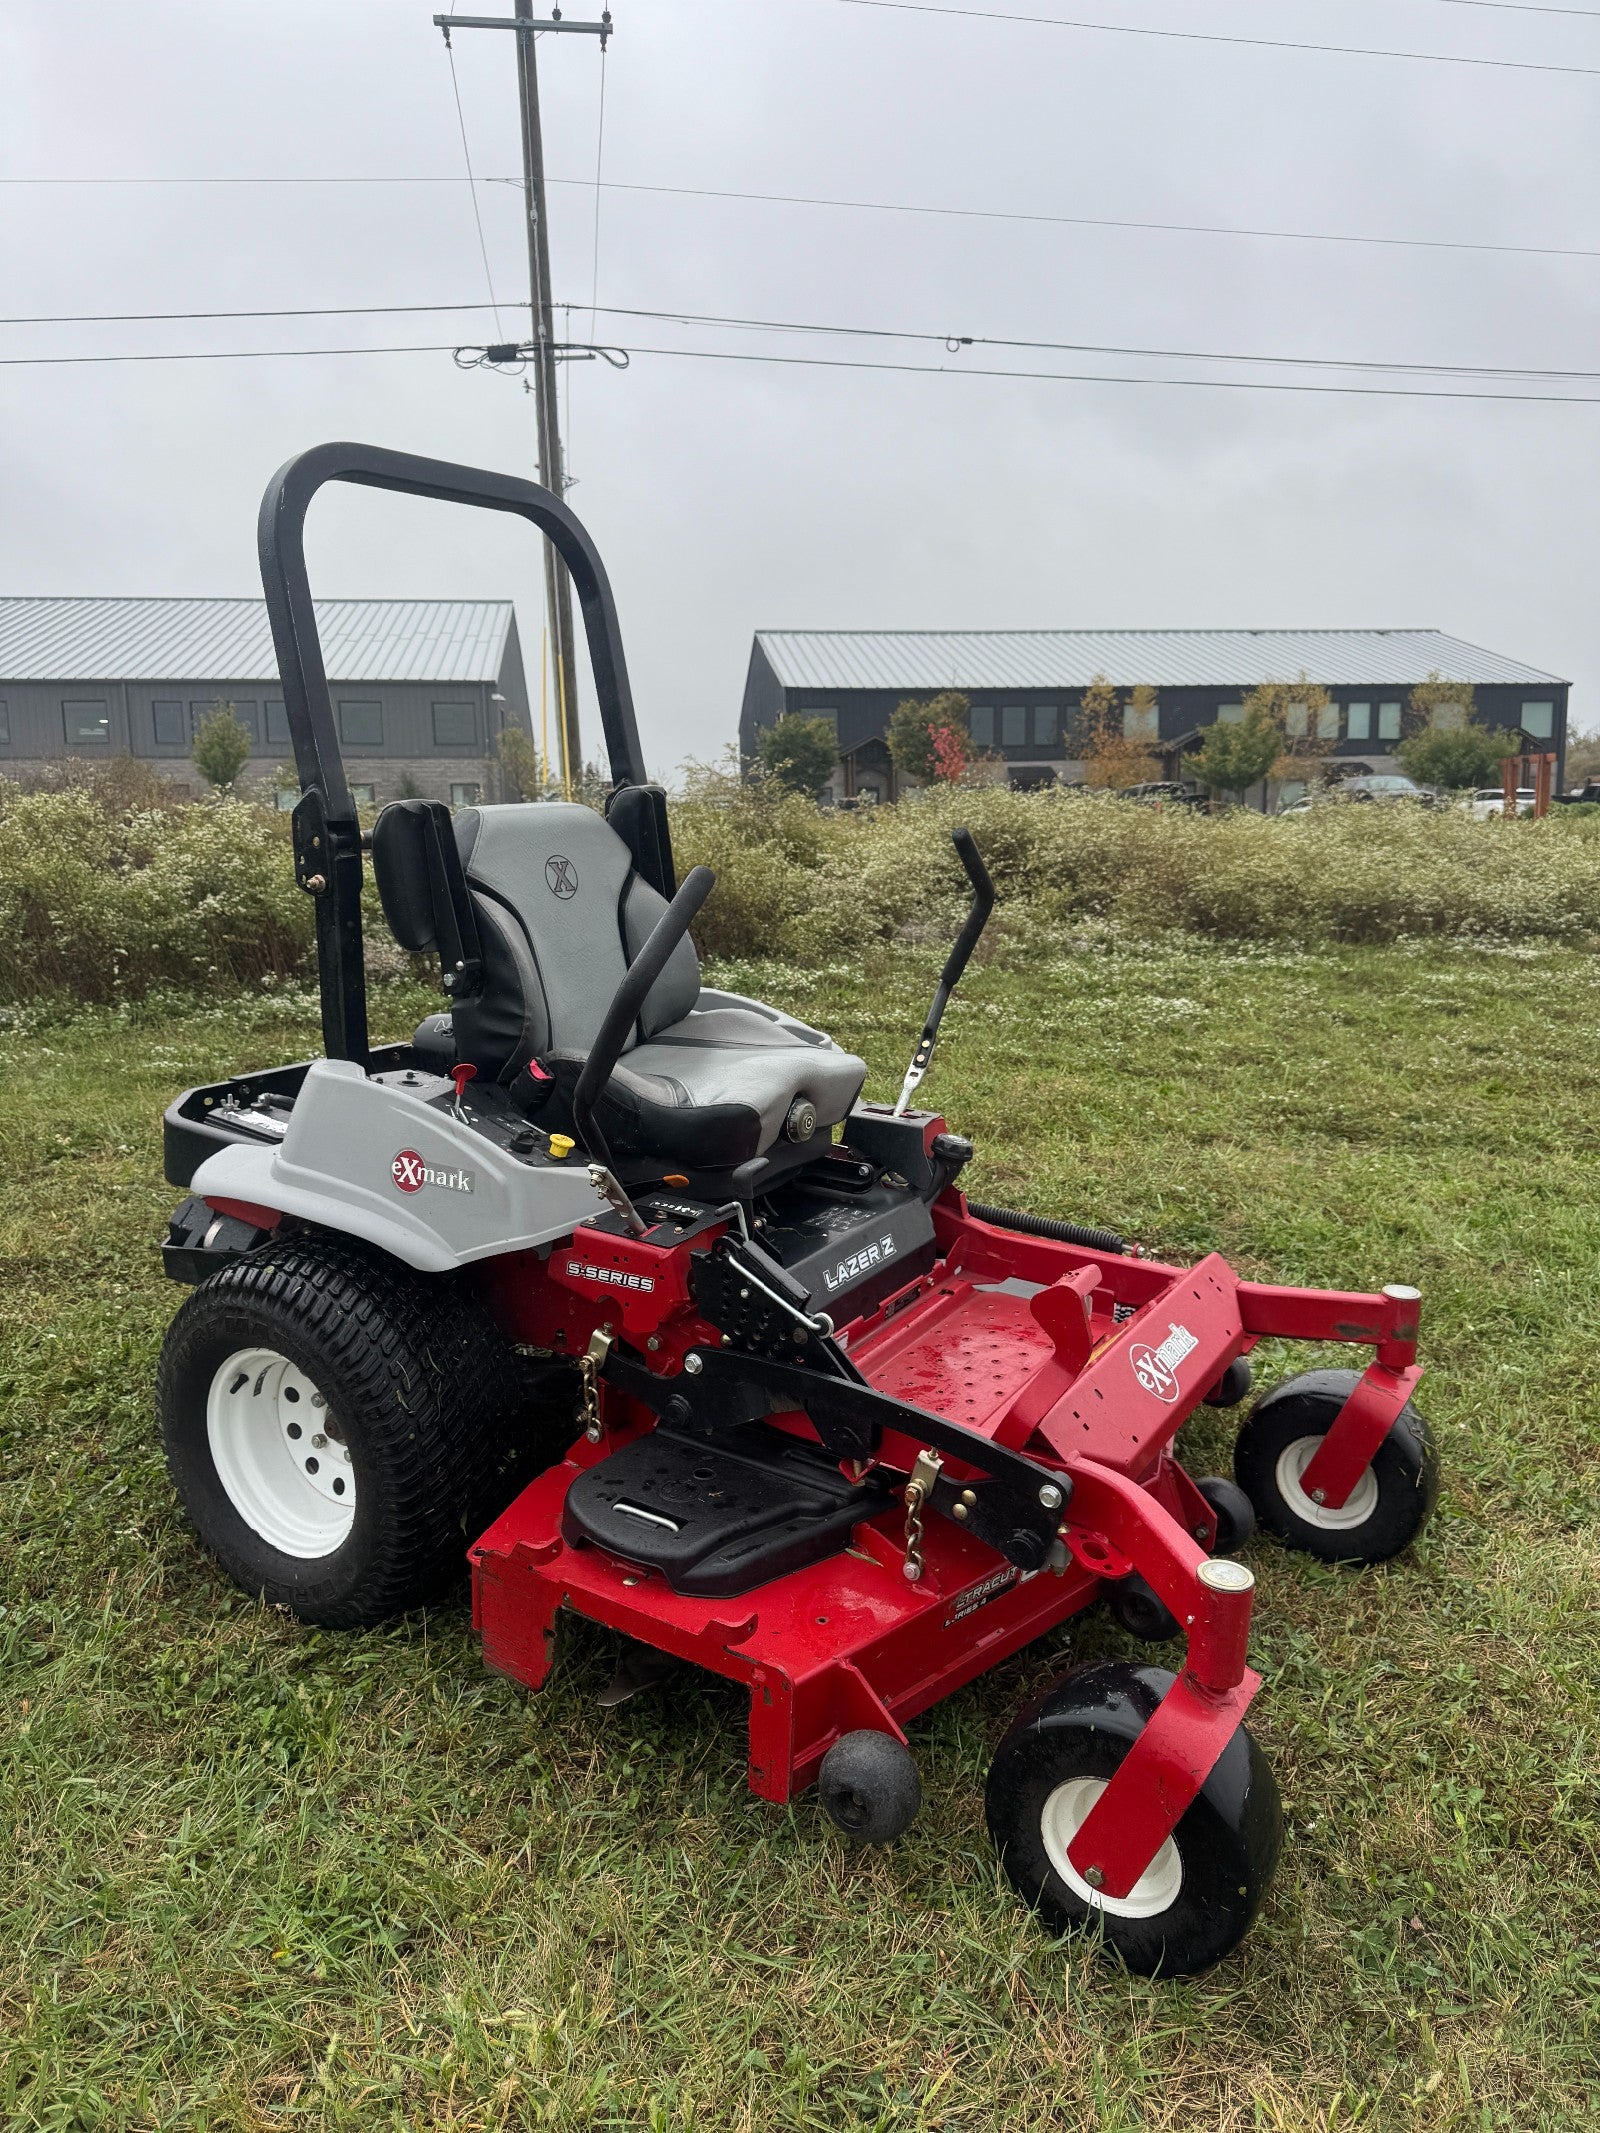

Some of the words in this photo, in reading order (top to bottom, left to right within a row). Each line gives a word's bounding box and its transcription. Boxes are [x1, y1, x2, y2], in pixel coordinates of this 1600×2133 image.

[547, 861, 576, 892] X
[567, 1262, 654, 1292] S-SERIES
[823, 1243, 883, 1291] LAZER
[880, 1234, 897, 1259] Z
